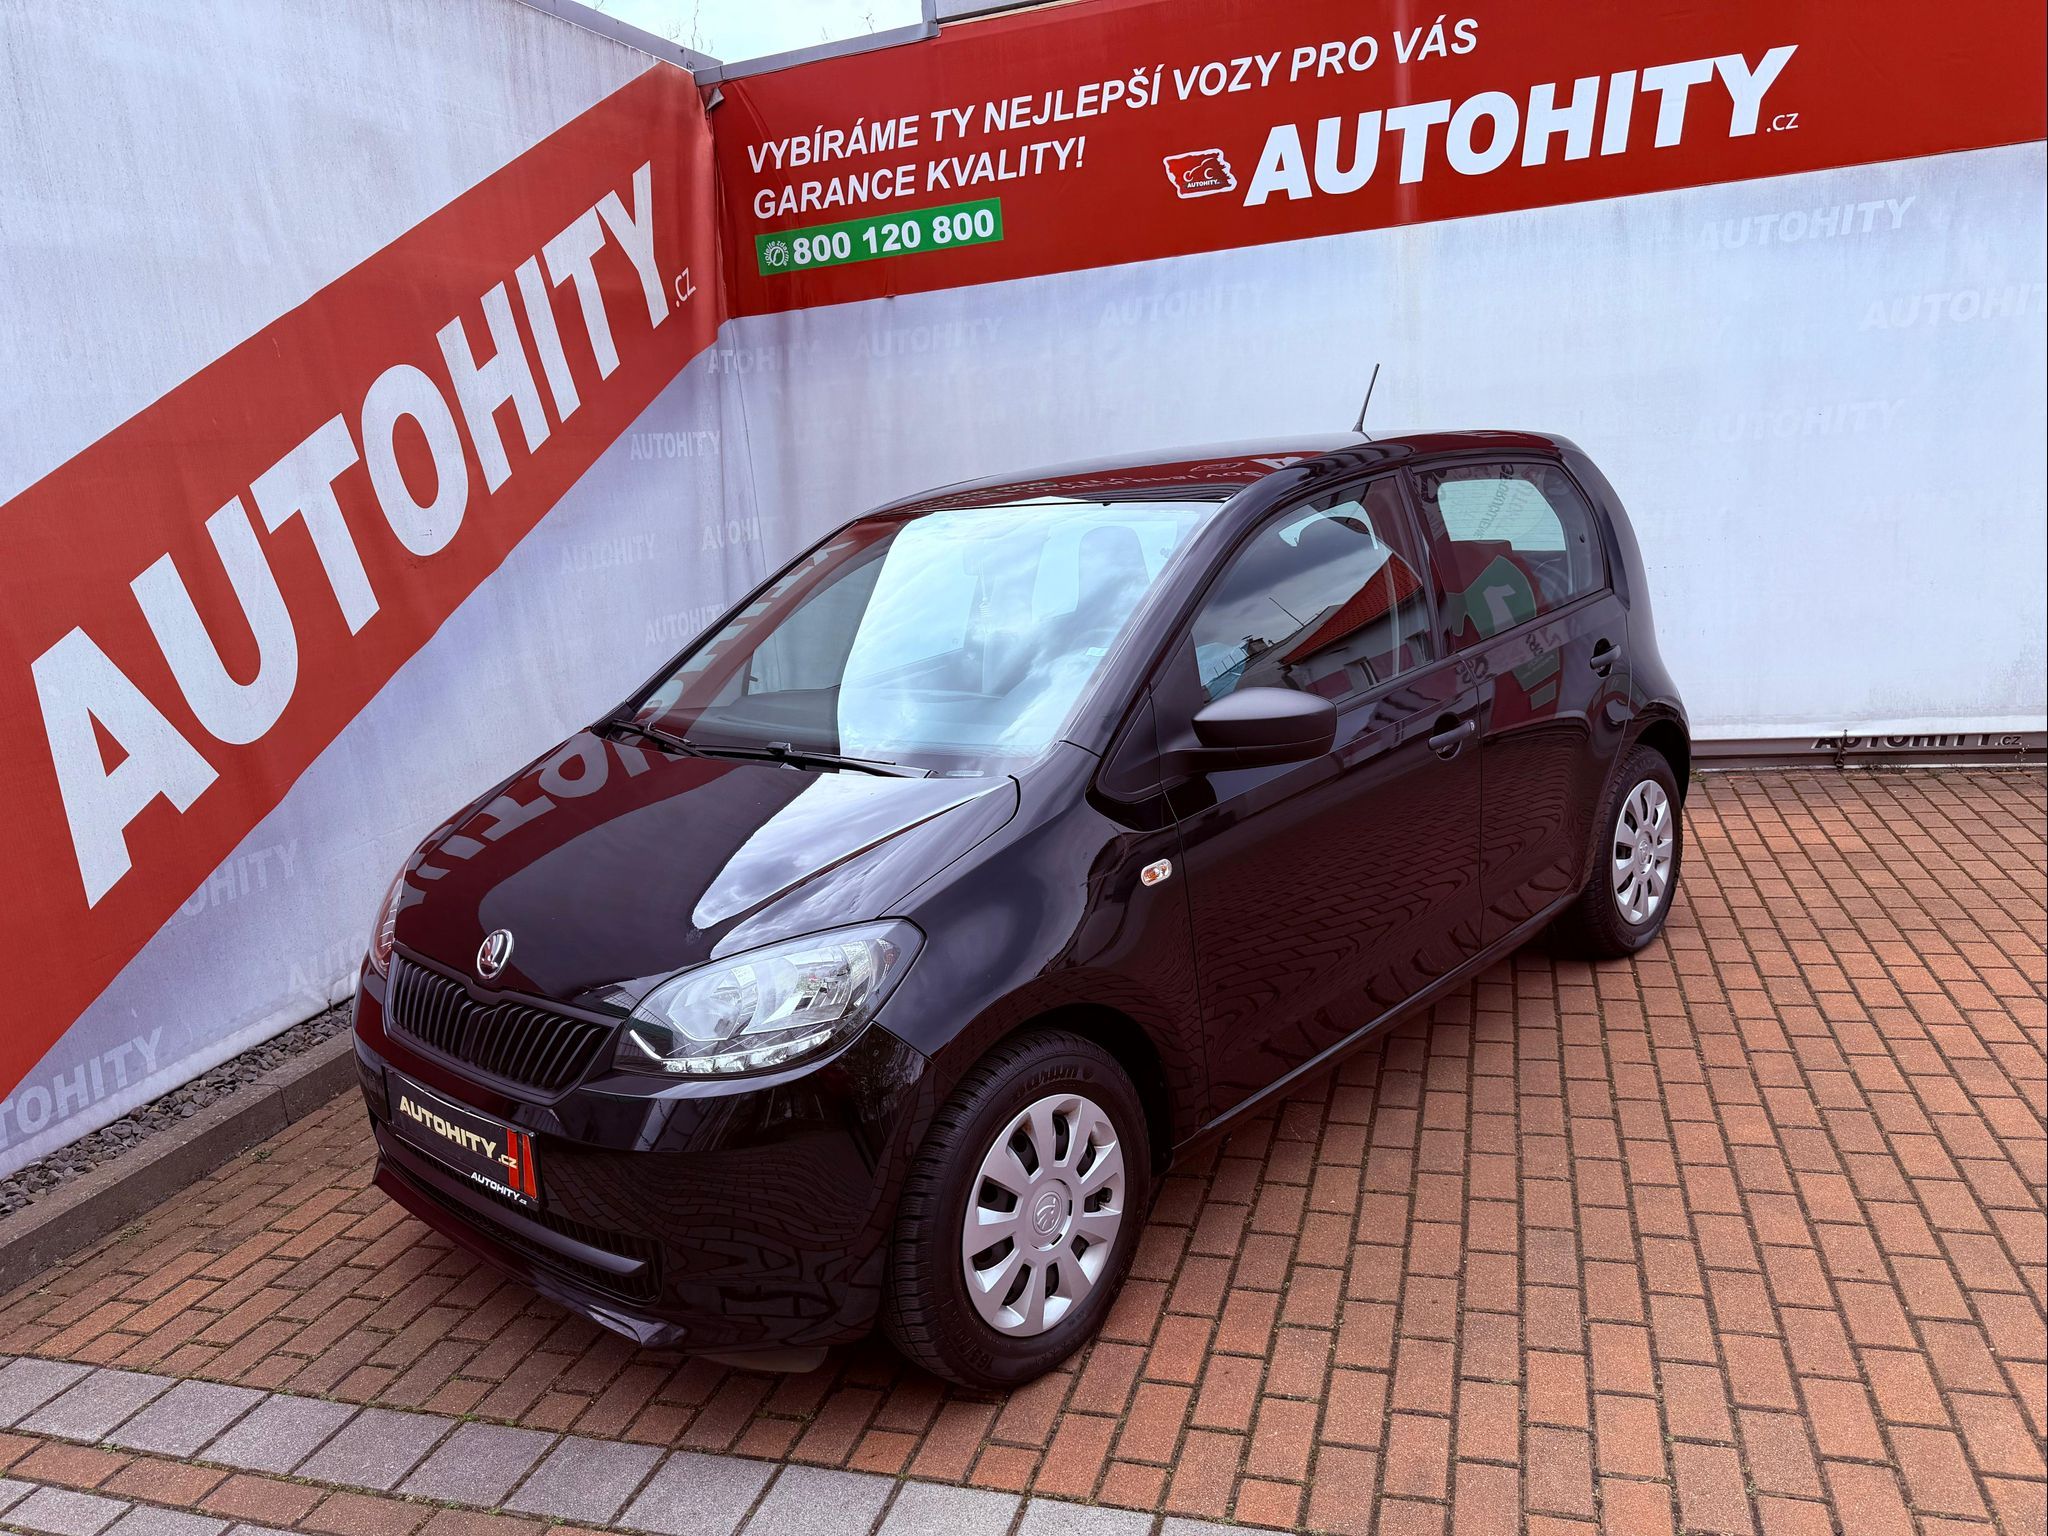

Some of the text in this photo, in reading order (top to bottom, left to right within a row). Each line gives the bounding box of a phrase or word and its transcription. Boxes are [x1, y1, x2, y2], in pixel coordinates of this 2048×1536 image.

[747, 14, 1479, 174] VYBÍRÁME TY NEJLEPŠÍ VOZY PRO VÁS
[753, 135, 1087, 220] GARANCE KVALITY!
[793, 208, 995, 265] 800 120 800
